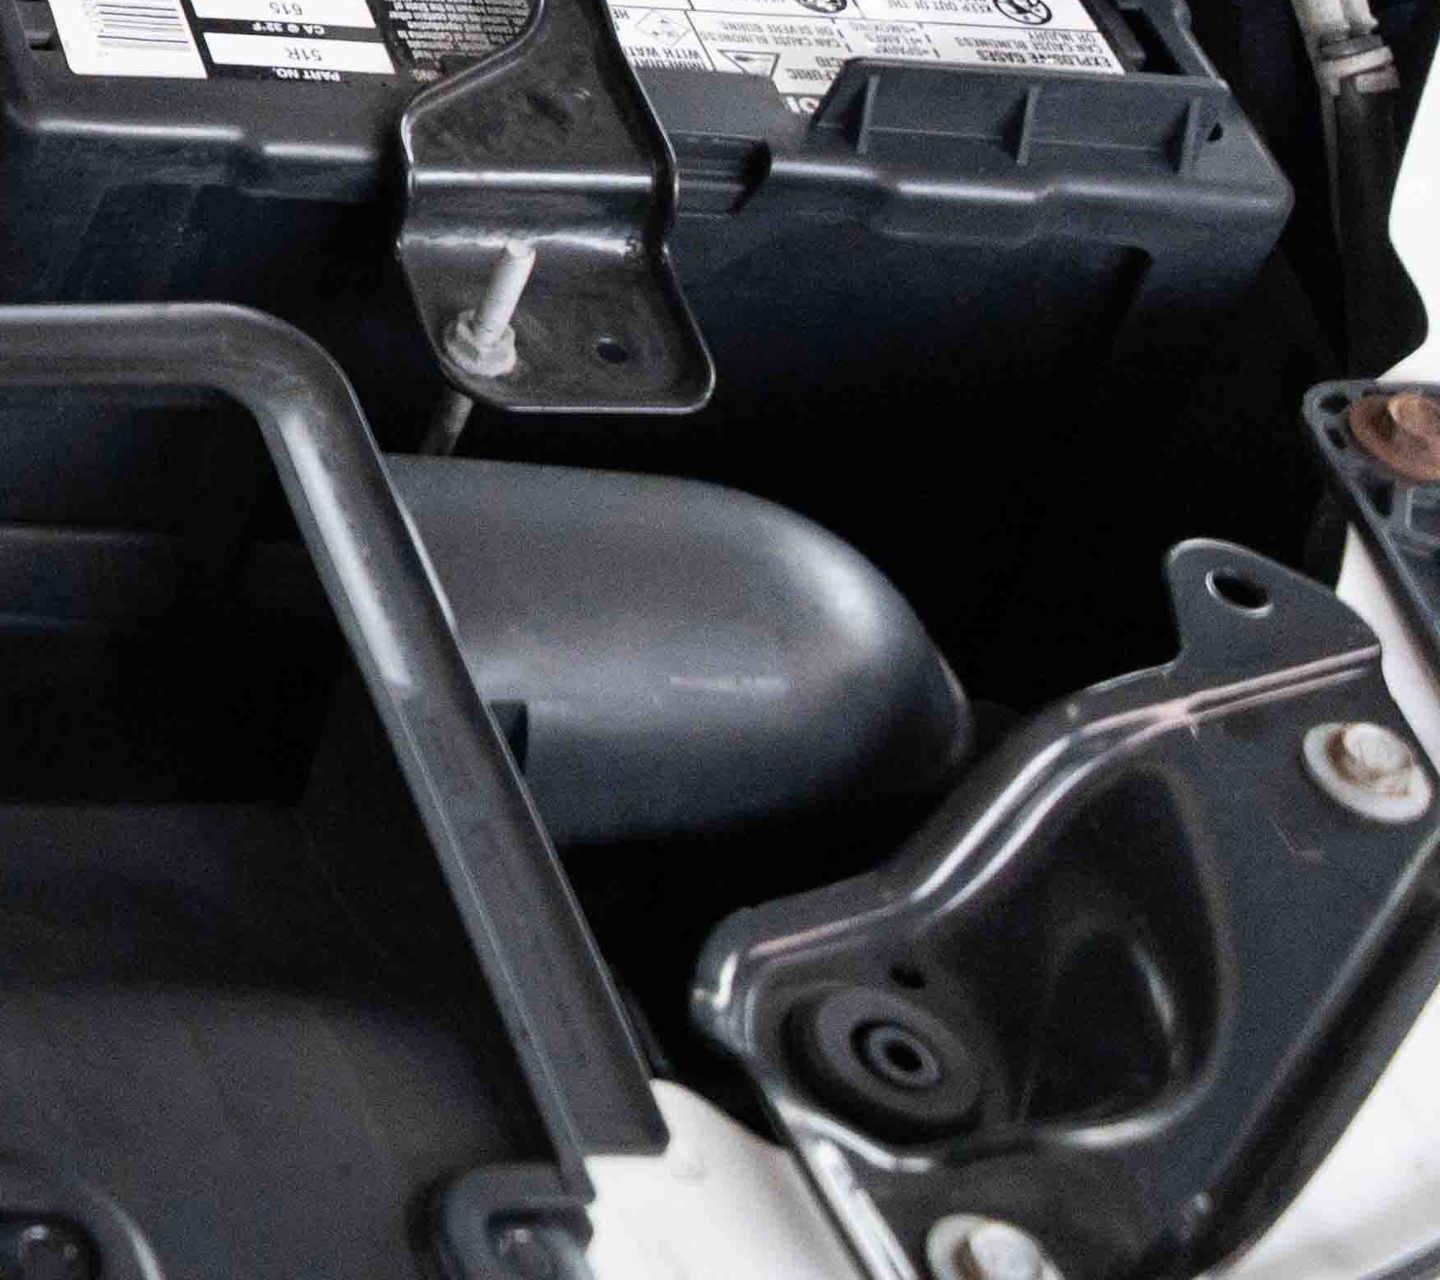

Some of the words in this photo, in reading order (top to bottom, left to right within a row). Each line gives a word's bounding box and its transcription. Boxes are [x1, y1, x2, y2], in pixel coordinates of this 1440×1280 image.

[302, 24, 326, 36] CA
[284, 46, 323, 63] 51R
[272, 66, 299, 81] NO.
[303, 69, 341, 83] PART
